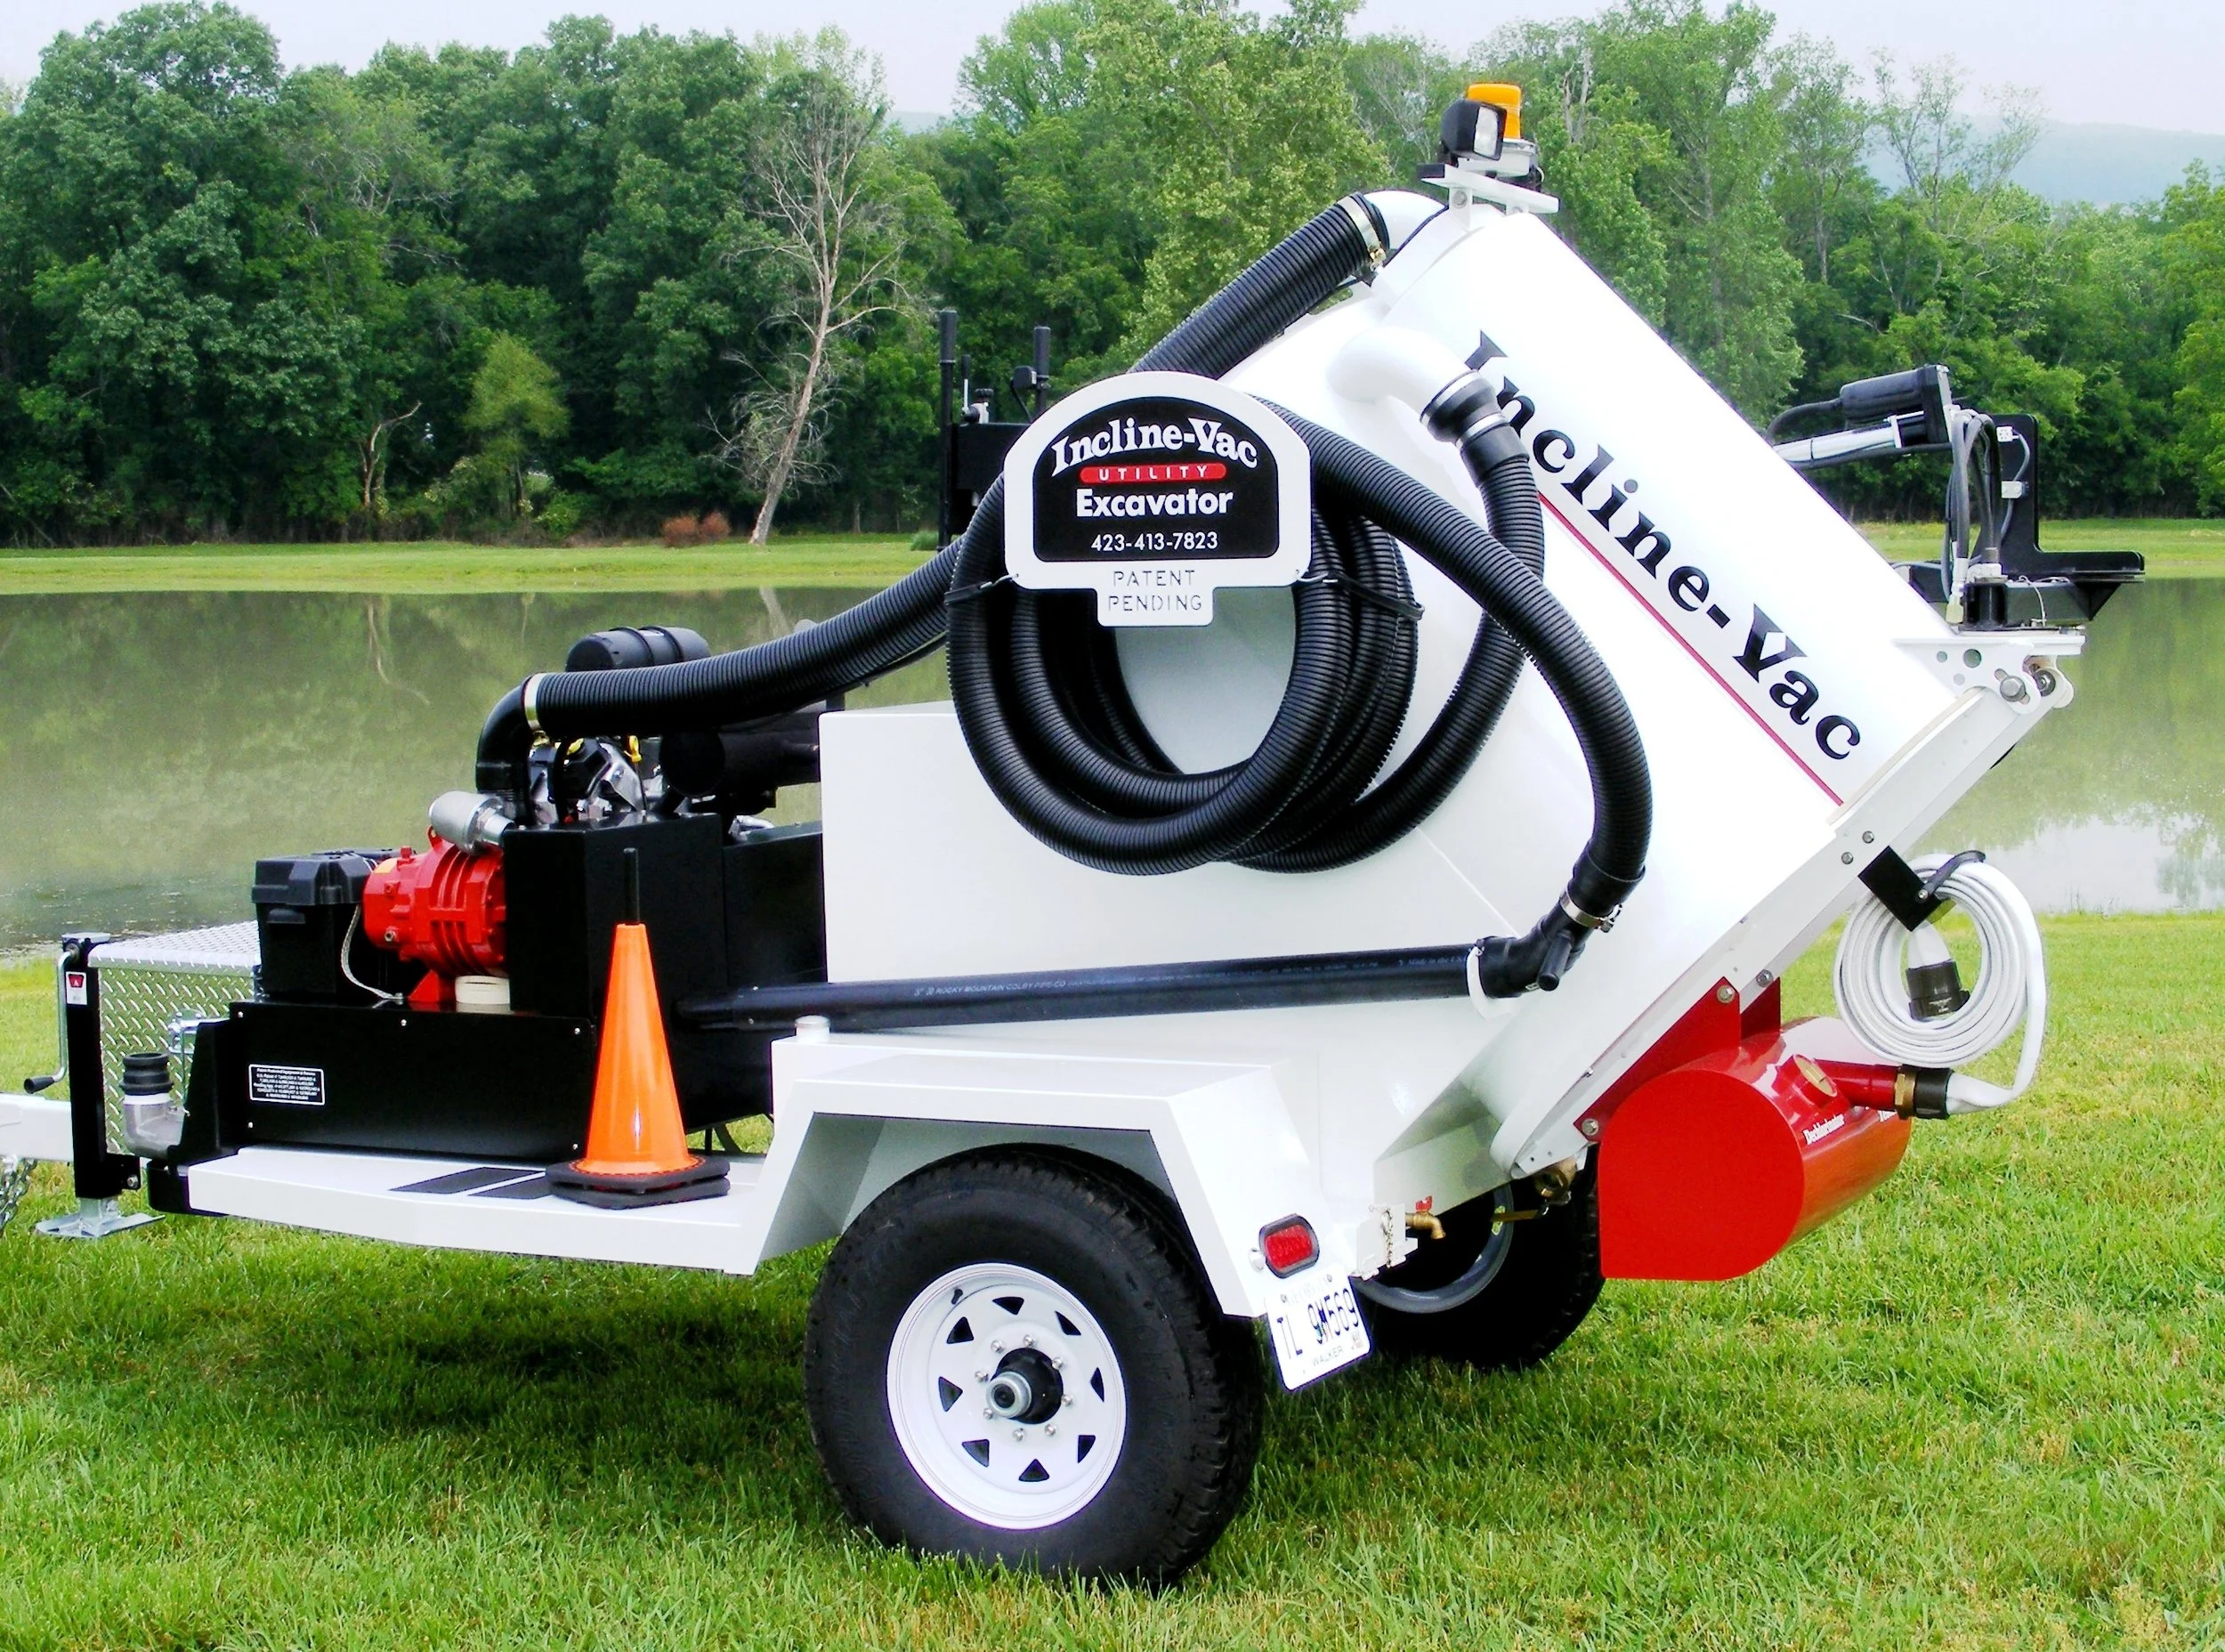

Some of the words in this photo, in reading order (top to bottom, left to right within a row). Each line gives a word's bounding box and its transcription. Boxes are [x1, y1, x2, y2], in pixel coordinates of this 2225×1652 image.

[1051, 417, 1258, 477] Incline-Vac
[1098, 465, 1209, 482] UTILITY
[1076, 489, 1234, 517] Excavator
[1091, 531, 1218, 551] 423-413-7823
[1112, 570, 1195, 587] PATENT
[1108, 595, 1202, 611] PENDING
